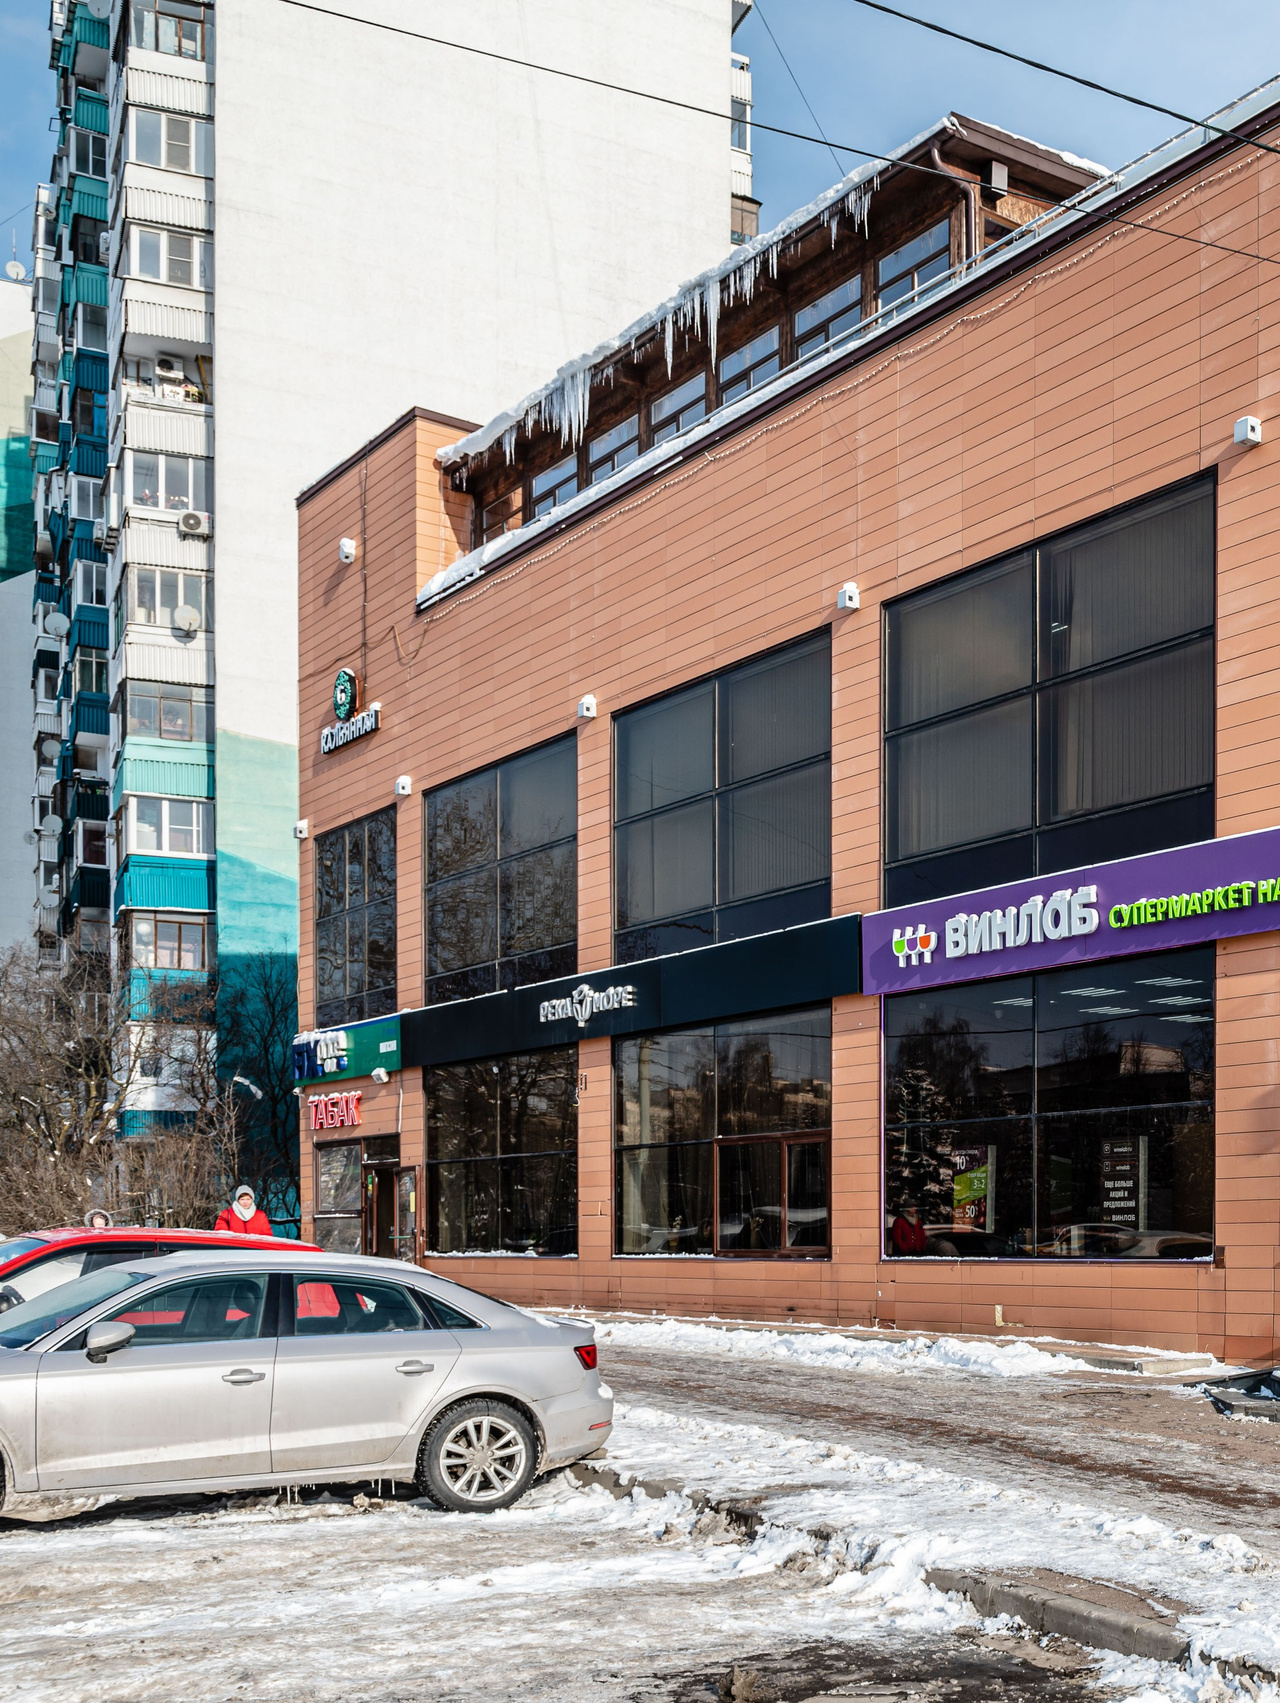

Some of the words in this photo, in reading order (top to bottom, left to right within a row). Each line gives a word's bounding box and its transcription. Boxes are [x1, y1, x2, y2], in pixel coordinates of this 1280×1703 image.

[320, 709, 378, 754] КАЛЬЯННАЯ
[1108, 880, 1255, 928] СУПЕРМАРКЕТ
[539, 998, 574, 1022] РЕКА
[592, 985, 635, 1012] МОРЕ
[308, 1092, 361, 1129] ТАБАК
